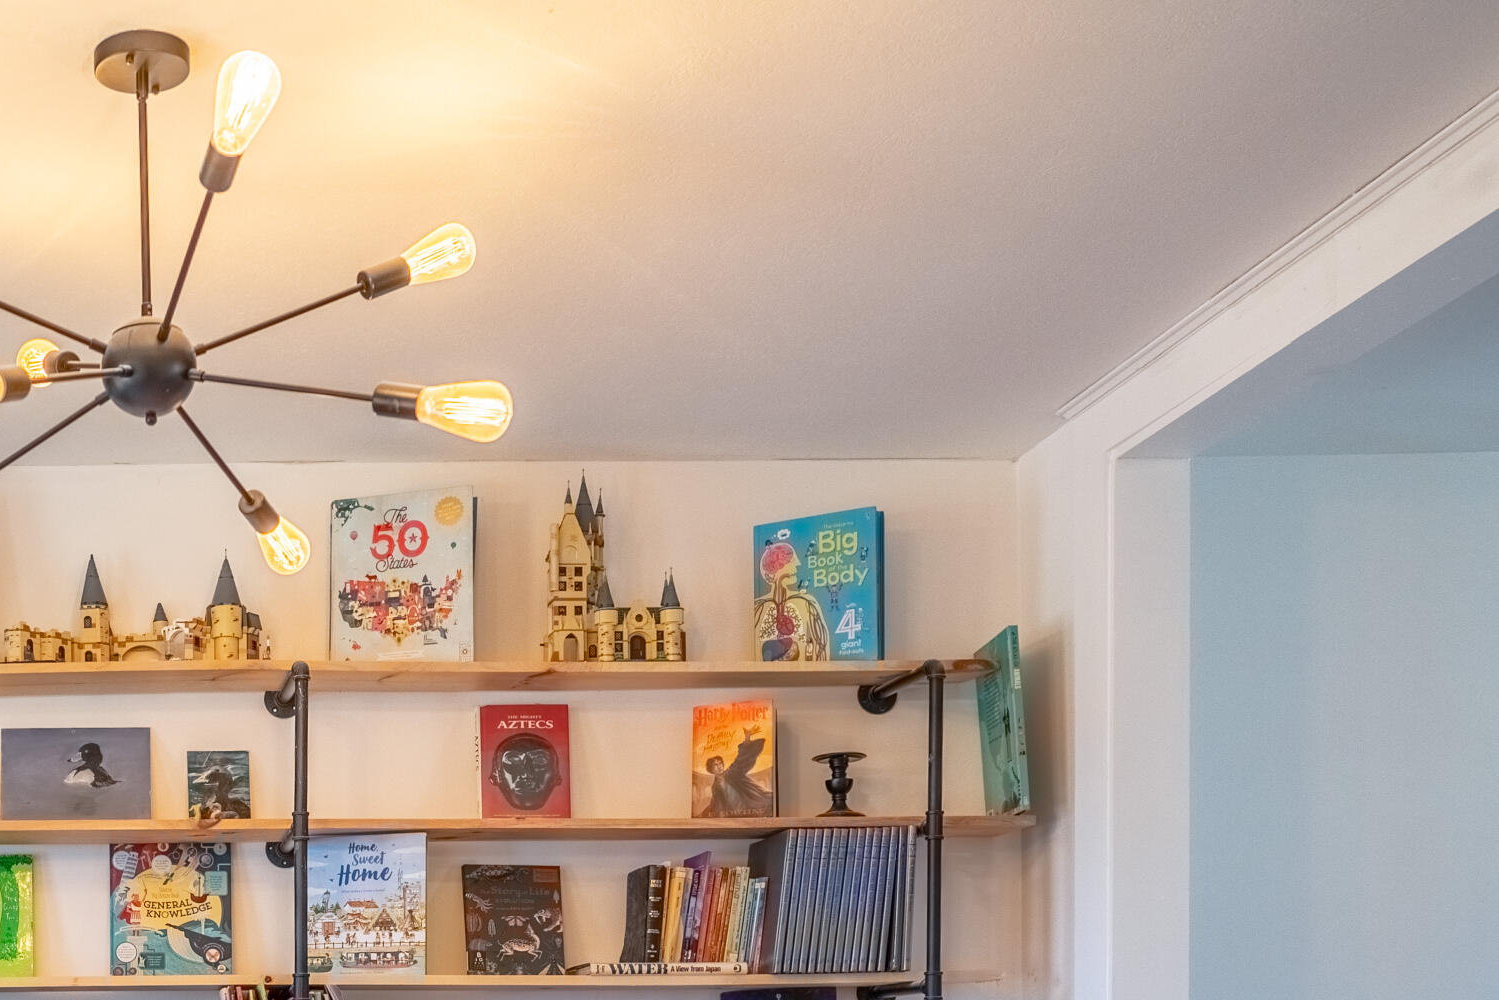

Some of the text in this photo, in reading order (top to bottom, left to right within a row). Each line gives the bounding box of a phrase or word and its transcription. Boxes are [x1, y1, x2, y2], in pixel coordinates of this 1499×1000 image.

[383, 506, 408, 524] The
[370, 520, 430, 561] 50
[818, 529, 858, 556] Big
[375, 555, 418, 573] States
[807, 552, 844, 569] Book
[813, 564, 869, 587] Body
[835, 608, 862, 640] 4
[840, 640, 862, 650] giant
[694, 703, 768, 727] Harry Potter
[497, 720, 554, 729] AZTECS
[352, 851, 387, 867] Sweet
[336, 864, 393, 887] Home
[143, 899, 192, 910] GENERAL
[146, 902, 213, 919] KNOWLEDGE
[609, 963, 668, 975] WATER
[675, 965, 690, 973] View
[705, 965, 722, 974] Japan
